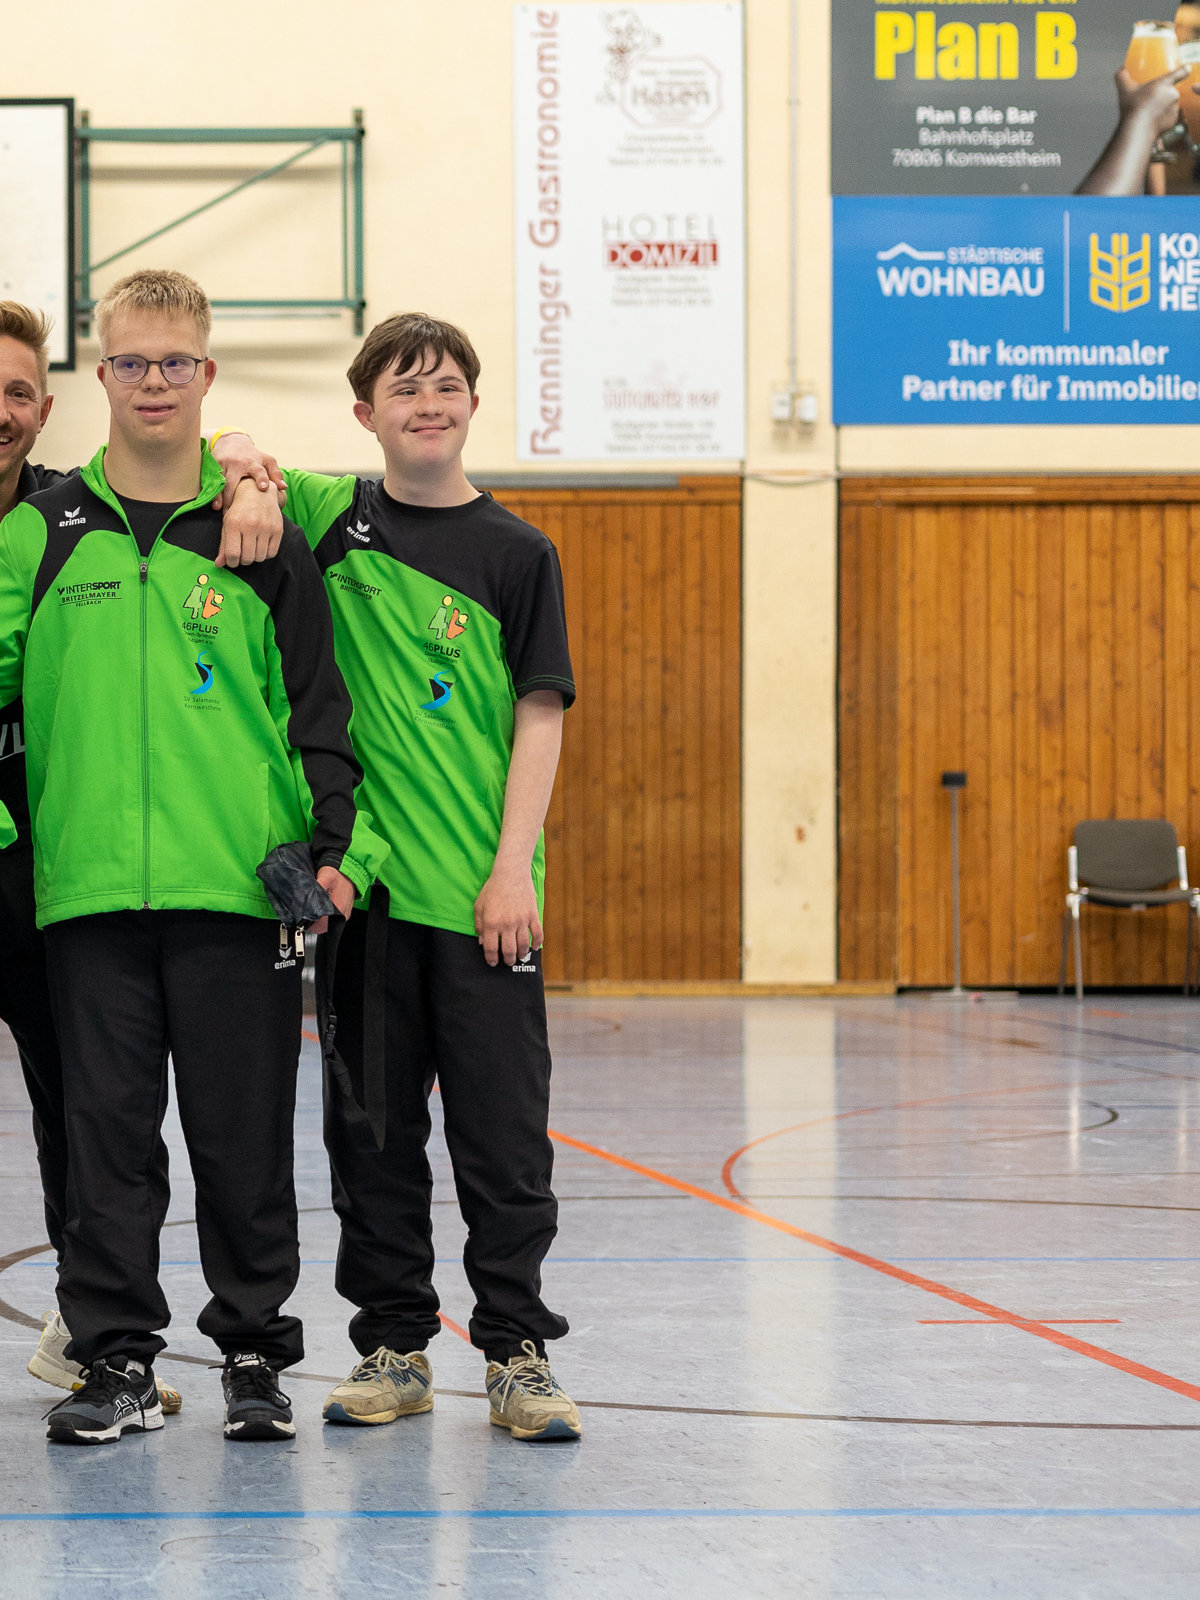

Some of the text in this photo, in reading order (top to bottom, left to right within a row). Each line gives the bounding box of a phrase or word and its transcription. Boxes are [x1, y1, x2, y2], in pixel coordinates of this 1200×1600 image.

[874, 11, 1078, 80] Plan B
[915, 106, 1038, 125] Plan B die Bar
[528, 10, 561, 248] Gastronomie
[918, 127, 1035, 148] Bahnhofsplatz
[892, 148, 1061, 167] 70806 Kornwestheim
[603, 213, 717, 239] HOTEL
[605, 241, 718, 269] DOMIZIL
[947, 244, 1044, 264] STÄDTISCHE
[1160, 232, 1200, 259] KO
[877, 266, 1045, 297] WOHNBAU
[1160, 285, 1200, 311] HE
[530, 262, 571, 455] Renninger
[948, 338, 1170, 366] Ihr kommunaler
[902, 374, 1200, 401] Partner für Immobilie
[59, 517, 86, 527] erima
[346, 526, 370, 543] erima
[62, 592, 116, 603] BRITZELMAYER
[66, 581, 121, 594] INTERSPORT
[76, 600, 102, 608] FELLBACH
[182, 622, 218, 634] 46PLUS
[423, 642, 461, 658] 46PLUS
[275, 960, 296, 969] erima
[512, 963, 536, 972] erima
